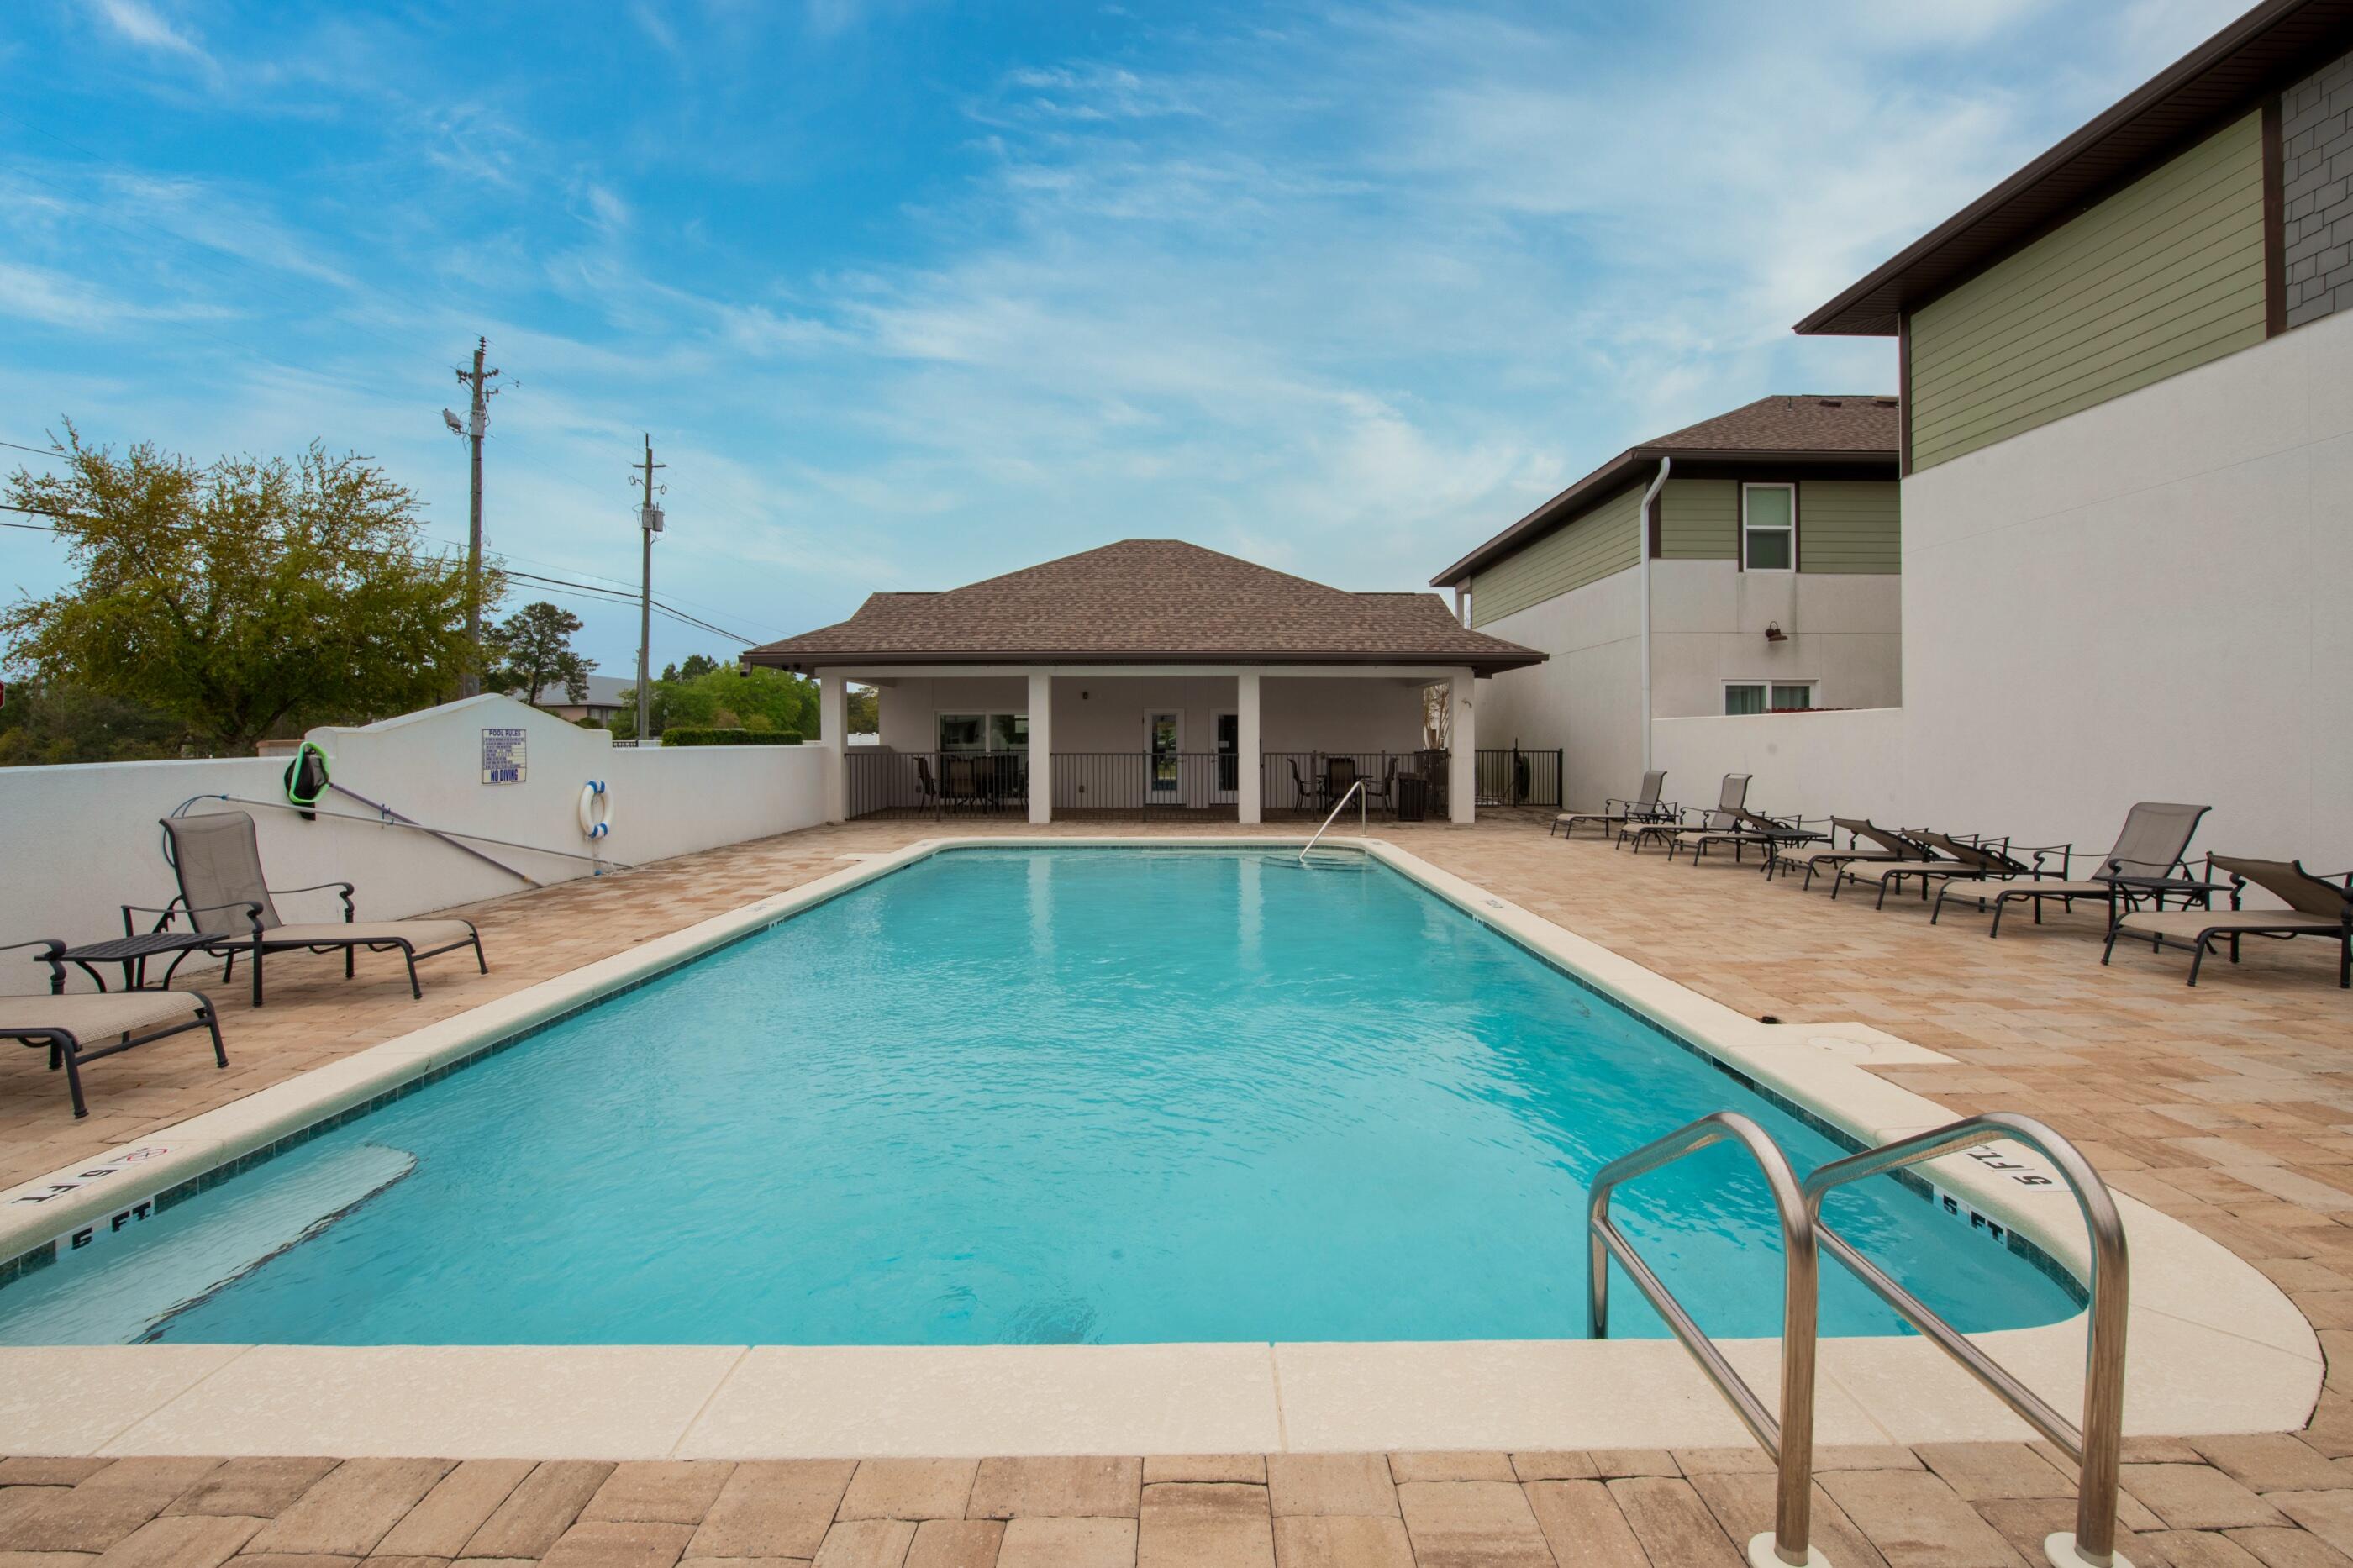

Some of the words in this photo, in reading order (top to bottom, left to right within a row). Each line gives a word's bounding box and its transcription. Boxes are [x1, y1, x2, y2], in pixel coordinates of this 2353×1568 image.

[491, 770, 499, 782] NO
[500, 769, 519, 781] DIVING
[78, 1169, 119, 1177] 5
[2013, 1176, 2052, 1185] 5
[1943, 1194, 1957, 1216] 5
